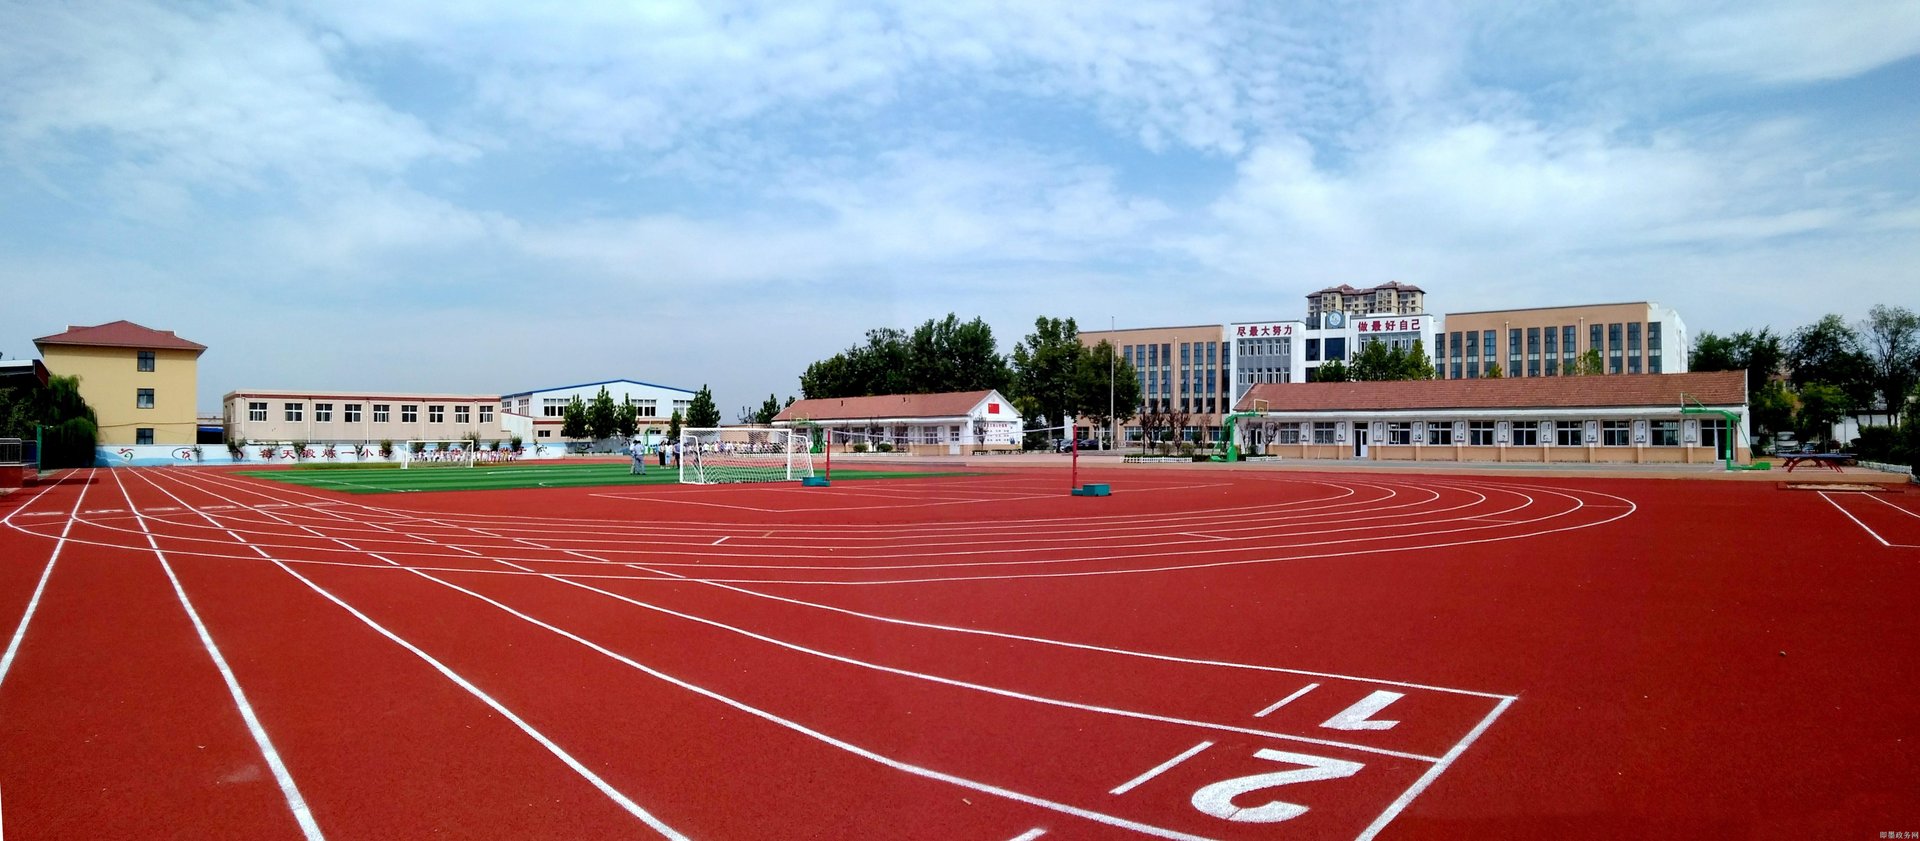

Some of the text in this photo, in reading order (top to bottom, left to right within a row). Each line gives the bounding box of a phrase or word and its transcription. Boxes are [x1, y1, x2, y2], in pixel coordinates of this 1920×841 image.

[1237, 324, 1292, 337] 尽最大努力
[1358, 319, 1421, 332] 做最好自己
[1319, 689, 1406, 730] 1
[1191, 747, 1366, 823] 2
